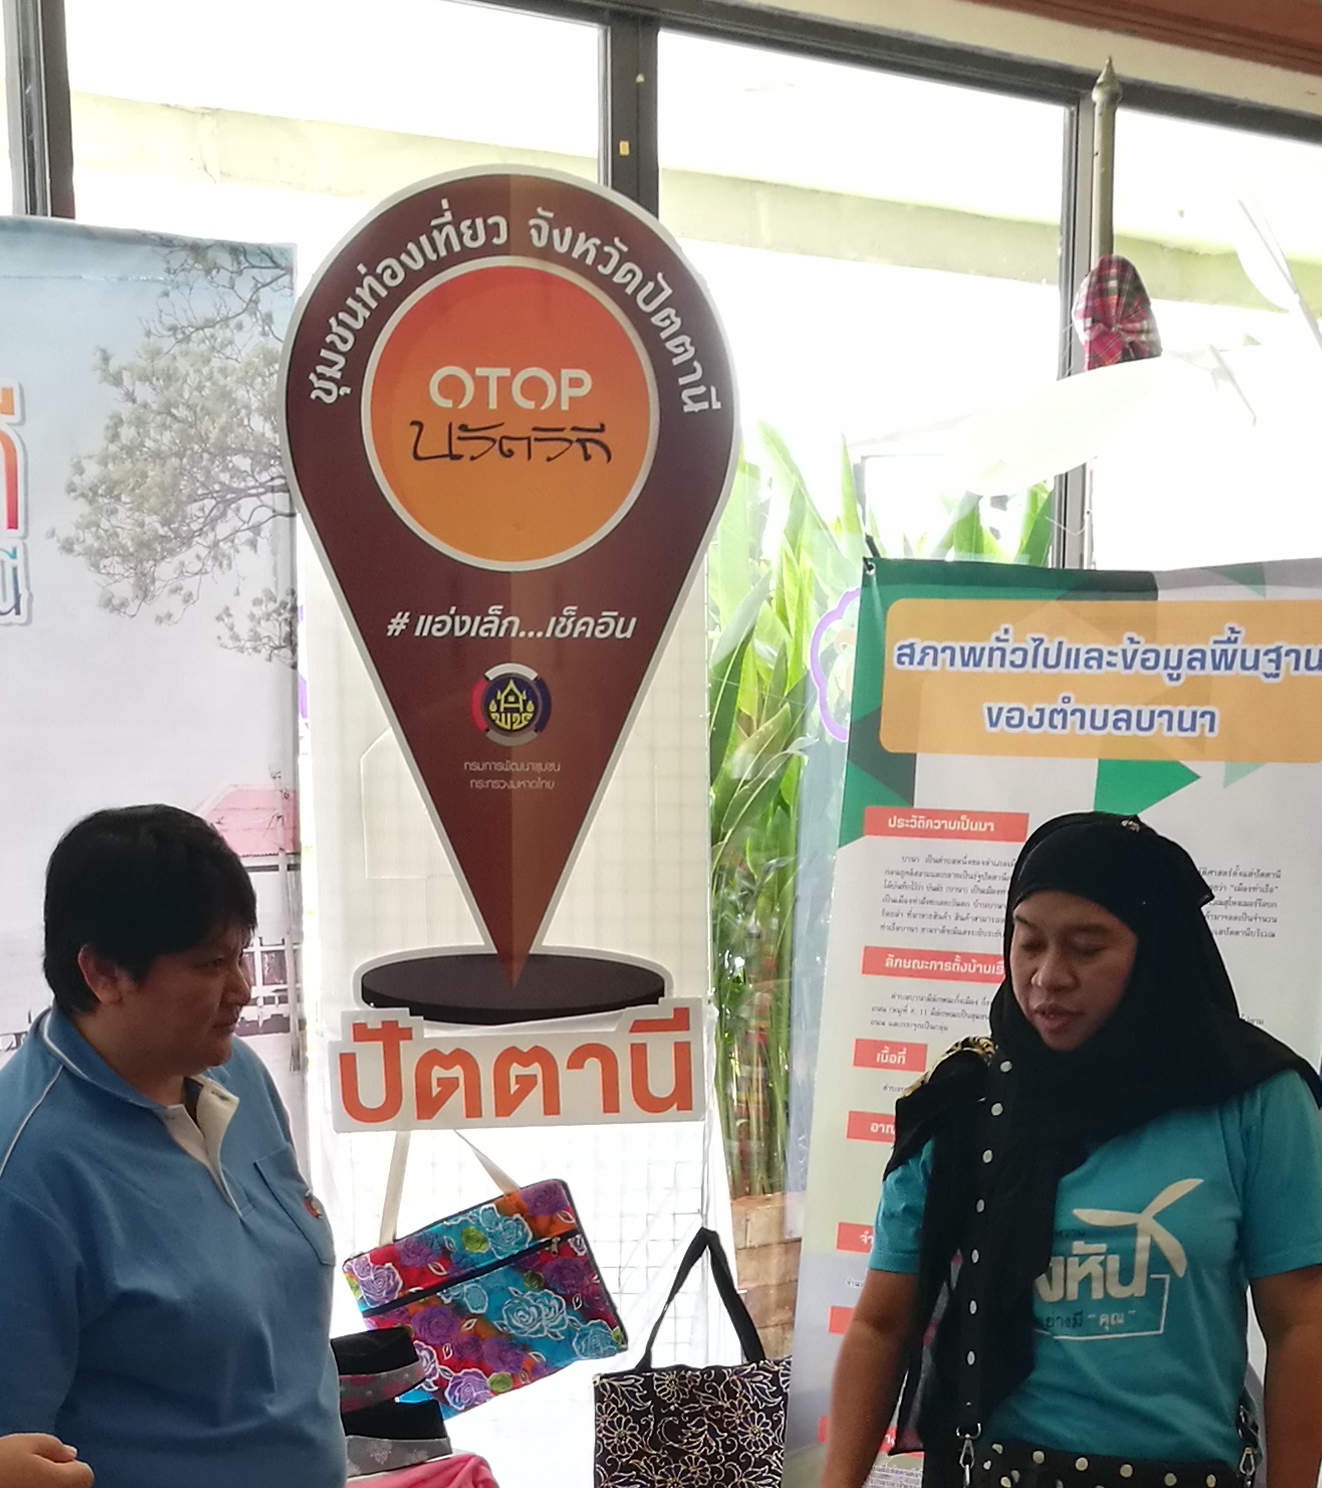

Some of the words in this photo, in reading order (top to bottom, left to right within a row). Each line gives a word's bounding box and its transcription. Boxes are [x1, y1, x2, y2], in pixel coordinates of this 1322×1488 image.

[310, 199, 508, 405] ชุมชนท่องเที่ยว
[528, 207, 722, 413] จังหวัดปัตตานี
[428, 365, 592, 411] OTOP
[985, 695, 1218, 735] ของตำบลบานา
[887, 815, 995, 832] ประวัติความเป็นมา
[885, 954, 1005, 976] ลักษณะการตั้งบ้านเรื
[338, 1006, 693, 1124] ปัตตานี
